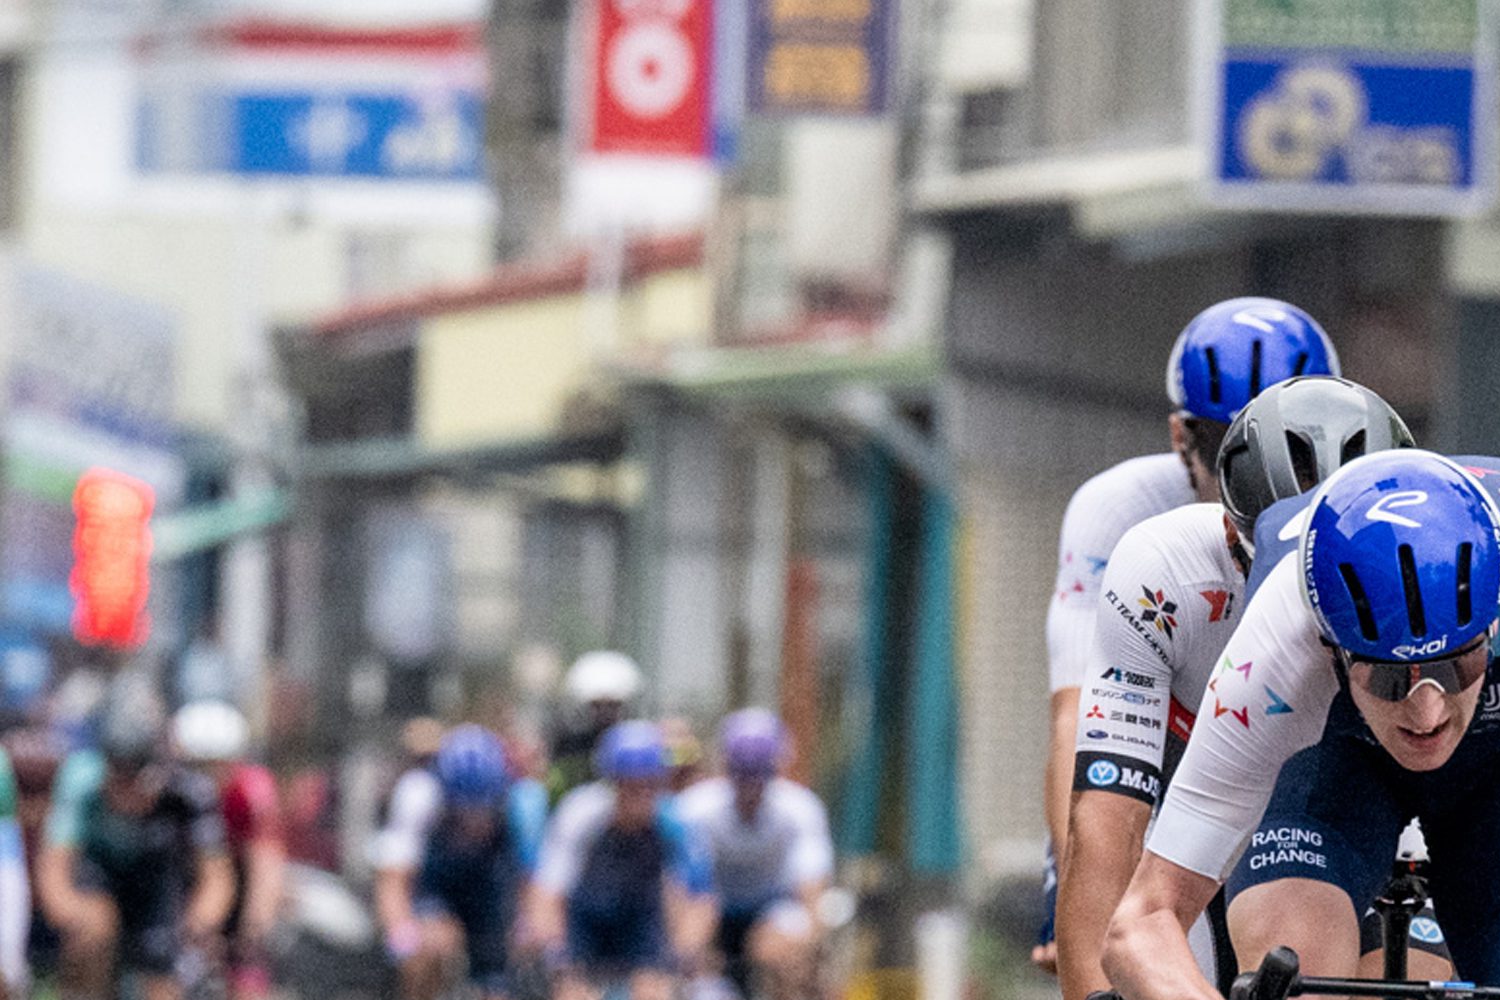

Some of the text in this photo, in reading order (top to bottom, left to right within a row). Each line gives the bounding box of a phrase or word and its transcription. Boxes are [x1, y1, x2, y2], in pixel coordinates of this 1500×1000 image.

[1252, 827, 1323, 848] RACING
[1277, 841, 1298, 849] FOR
[1249, 849, 1328, 870] CHANGE
